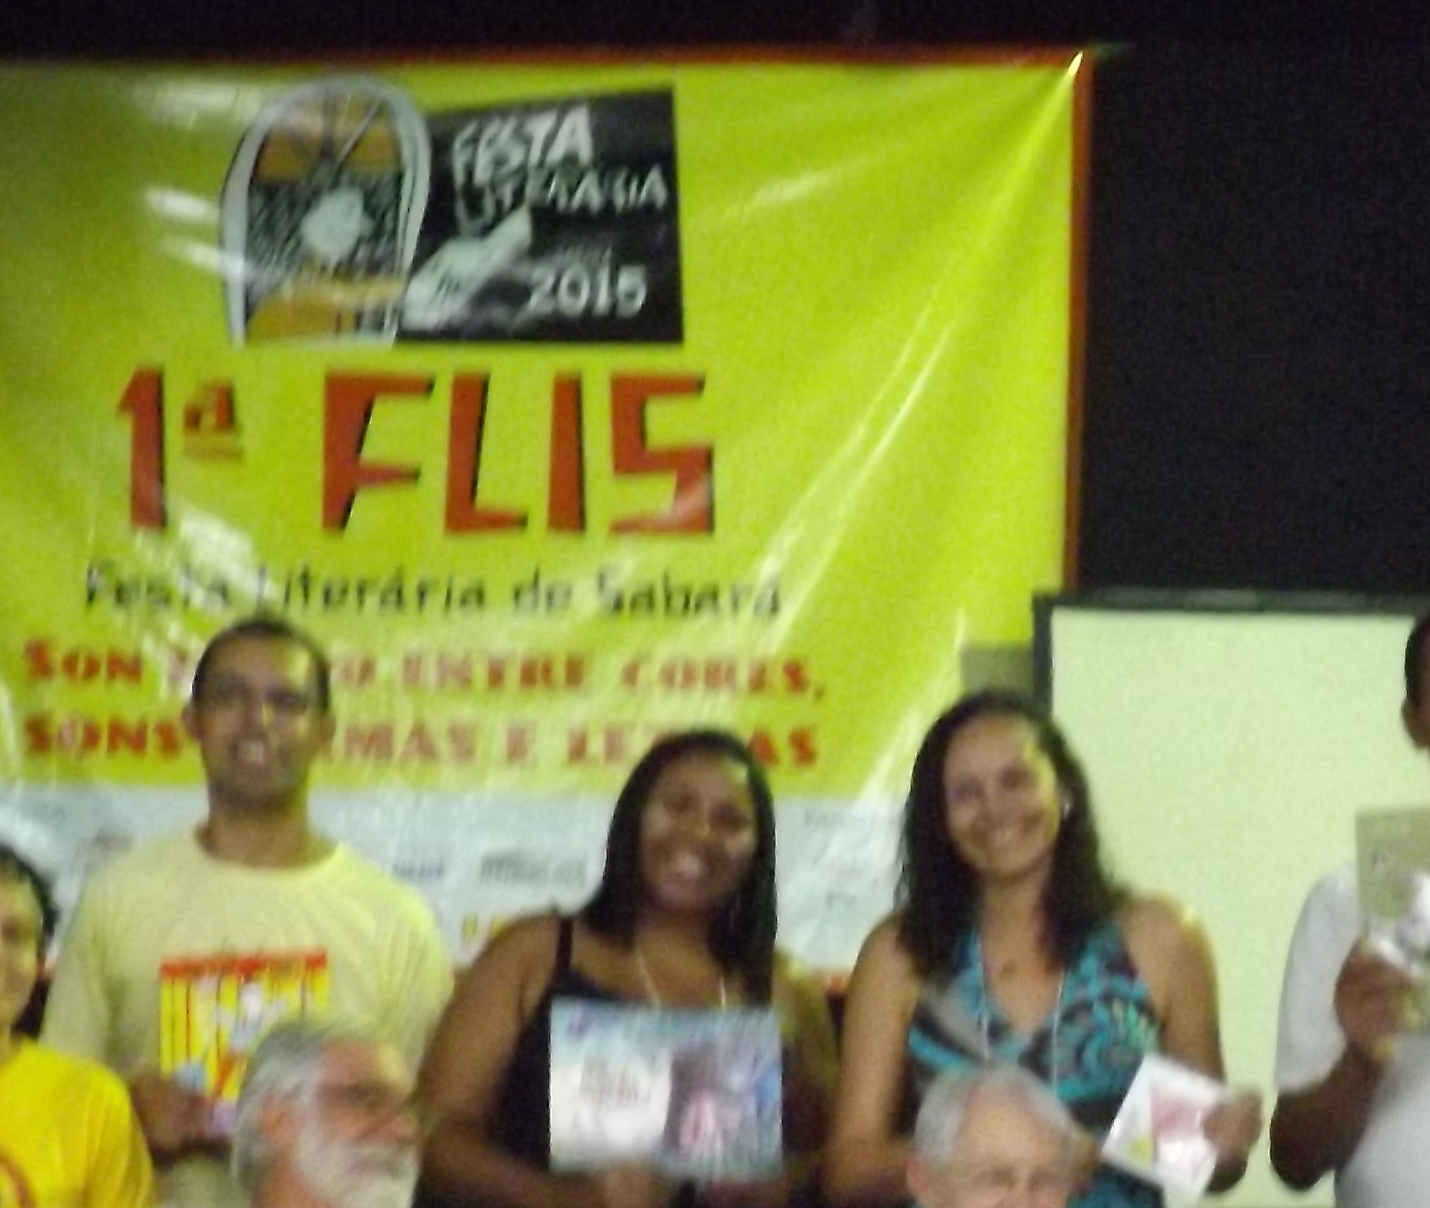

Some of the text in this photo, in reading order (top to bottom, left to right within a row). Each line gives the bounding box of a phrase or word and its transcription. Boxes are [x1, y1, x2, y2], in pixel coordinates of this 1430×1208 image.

[452, 102, 594, 190] FESTA
[526, 250, 648, 319] 2015
[321, 370, 715, 535] FLIS
[83, 561, 229, 608] Festa
[513, 566, 571, 613] de
[402, 651, 588, 691] ENTRE
[567, 720, 818, 767] LEAS
